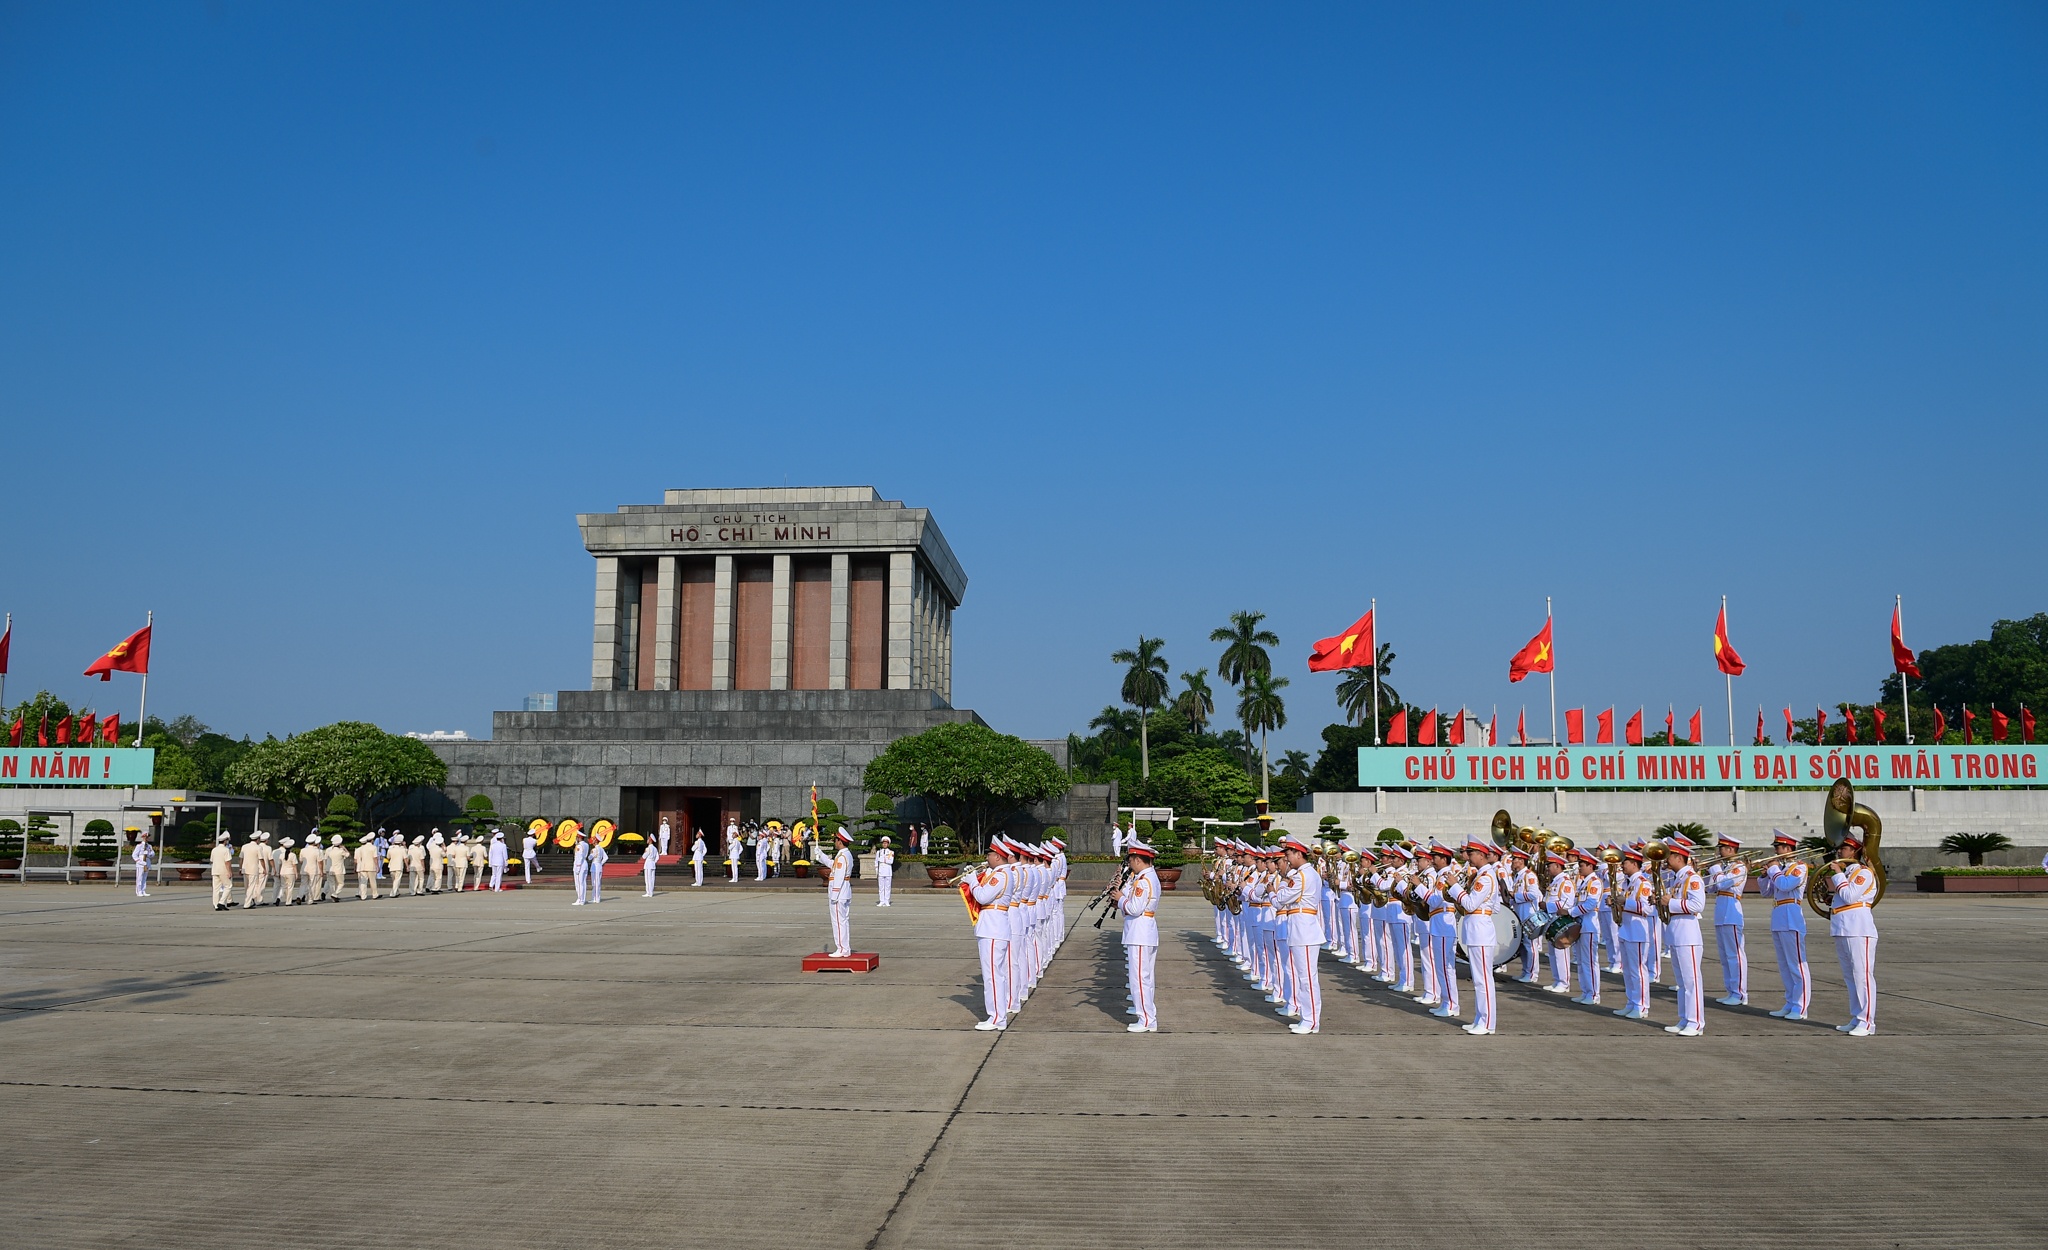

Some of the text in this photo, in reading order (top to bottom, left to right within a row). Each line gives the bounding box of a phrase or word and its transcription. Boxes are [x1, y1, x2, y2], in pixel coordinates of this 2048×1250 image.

[30, 751, 91, 779] NĂM
[1405, 747, 2037, 785] CHỦ TỊCH HỒ CHÍ MINH VĨ ĐẠI SỐNG MÃI TRONG
